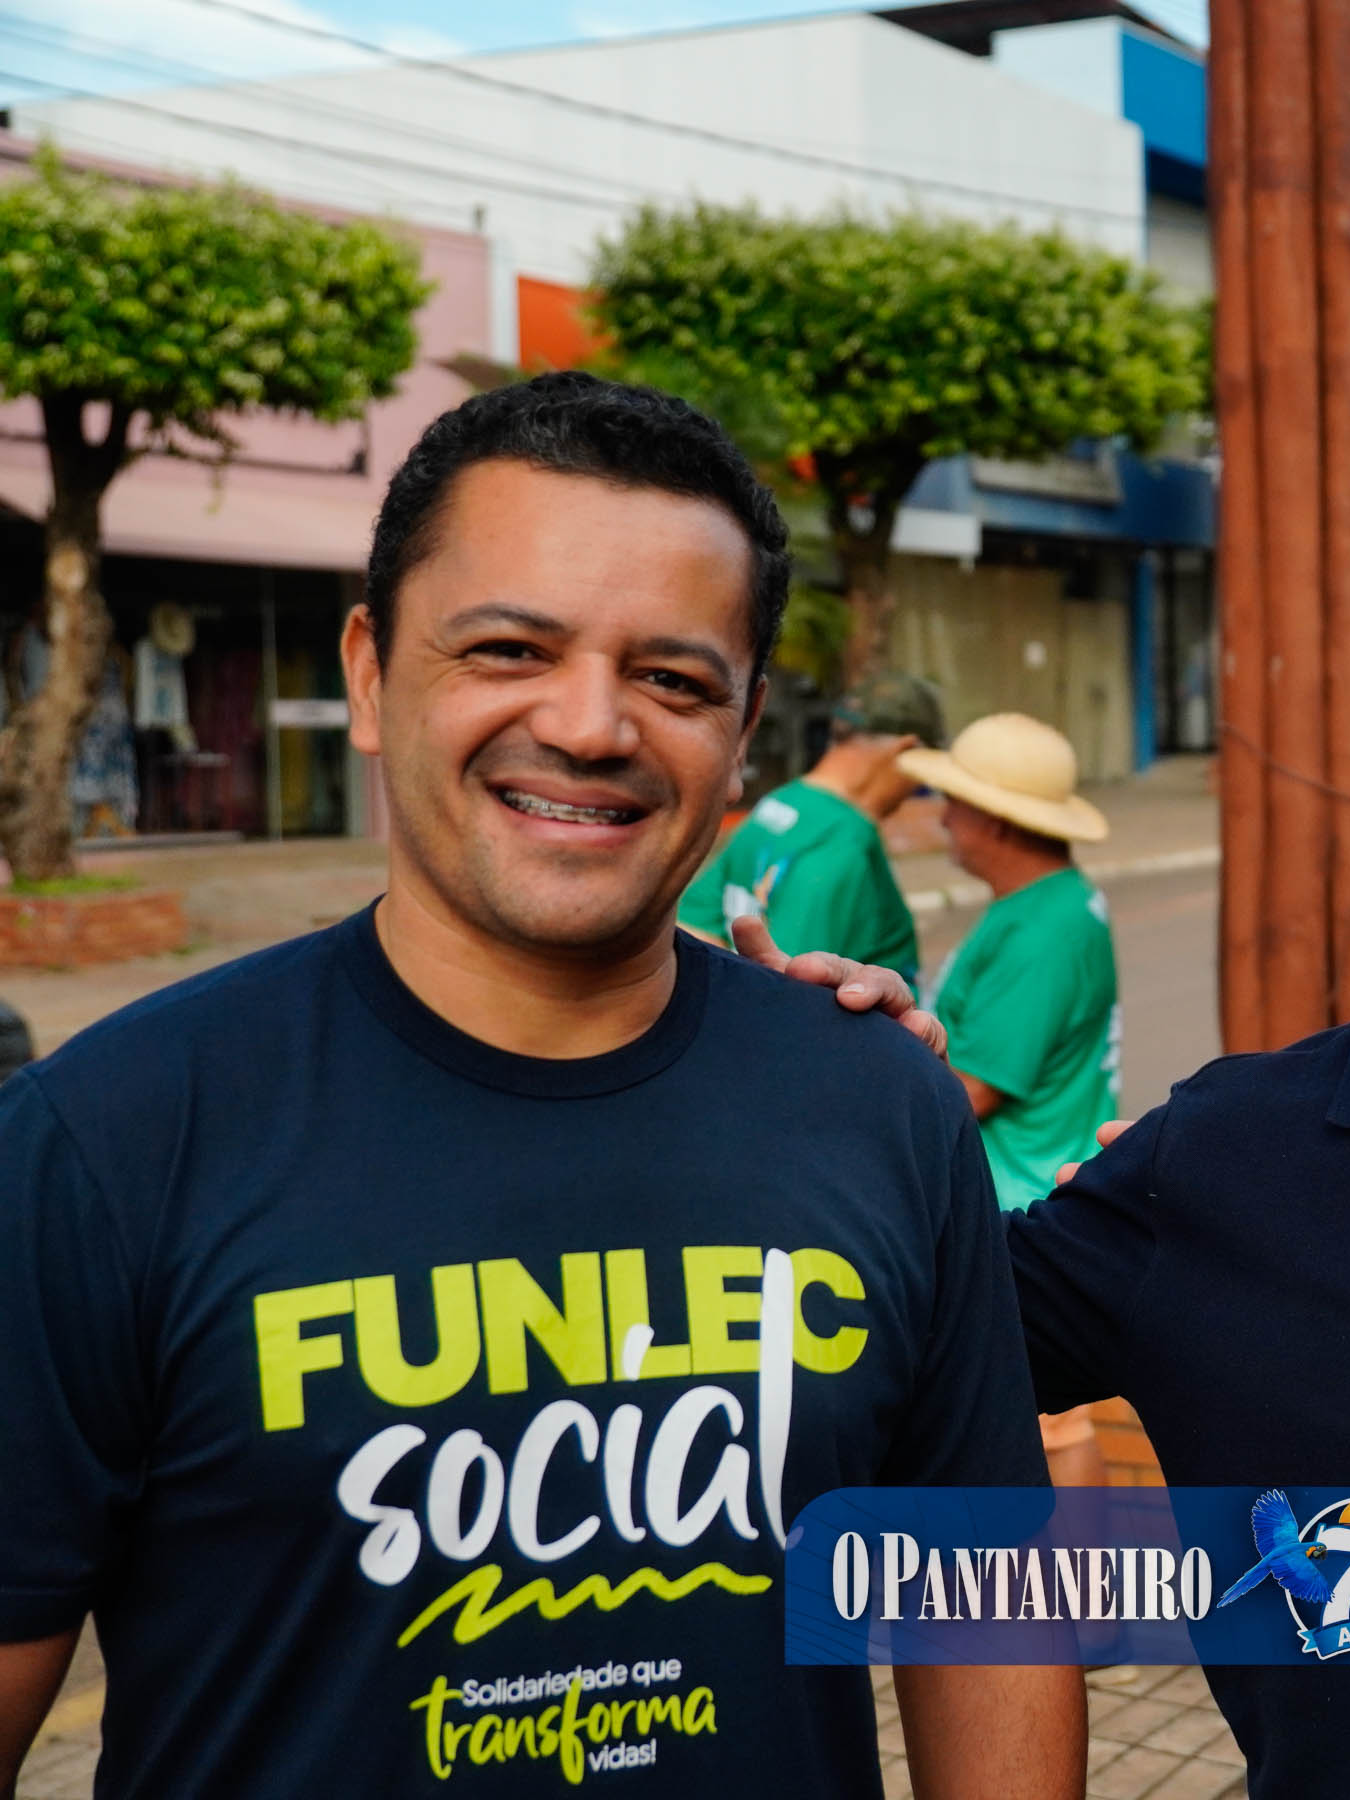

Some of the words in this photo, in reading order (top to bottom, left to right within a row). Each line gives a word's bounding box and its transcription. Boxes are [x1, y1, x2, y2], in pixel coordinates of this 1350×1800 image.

[254, 1246, 869, 1432] FUNLEC
[337, 1248, 801, 1587] social
[409, 1675, 718, 1784] transforma
[462, 1664, 628, 1707] Solidariedade
[631, 1658, 683, 1687] que
[587, 1738, 657, 1772] vidas!
